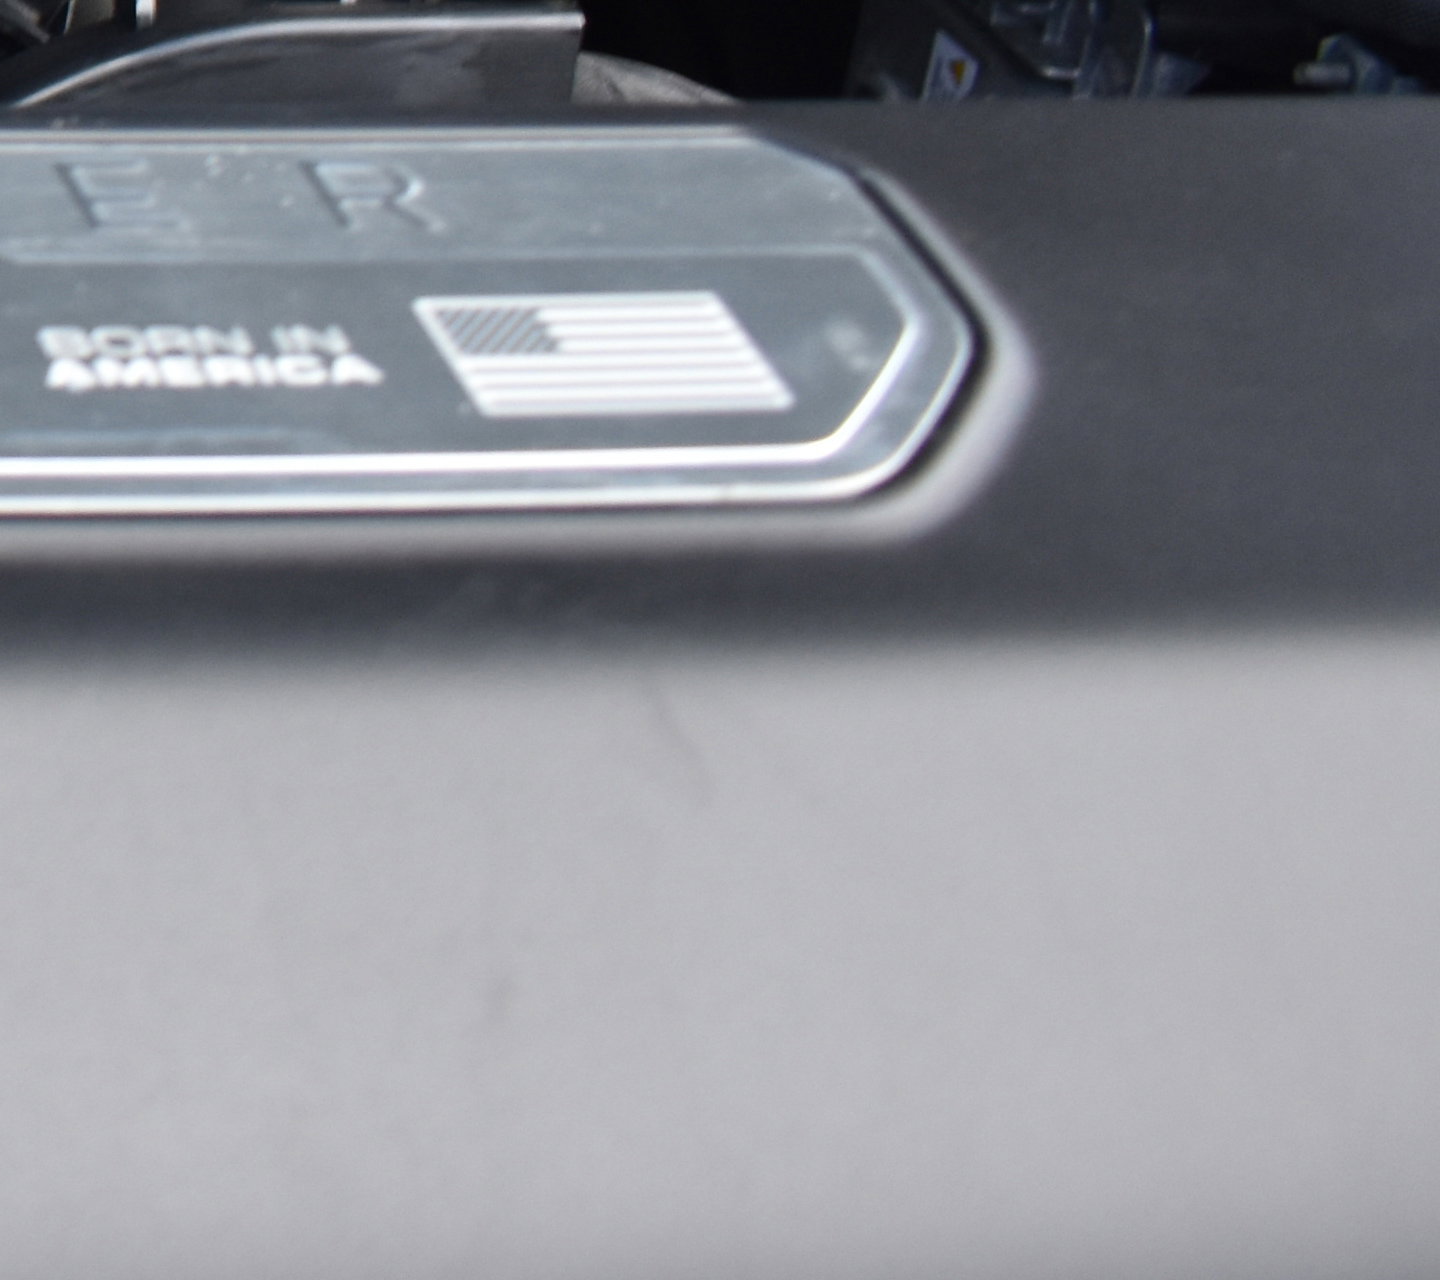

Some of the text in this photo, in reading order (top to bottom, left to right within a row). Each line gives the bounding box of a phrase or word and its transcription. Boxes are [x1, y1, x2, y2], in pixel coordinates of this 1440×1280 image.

[36, 323, 352, 359] BORN IN
[44, 354, 385, 392] AMERICA
